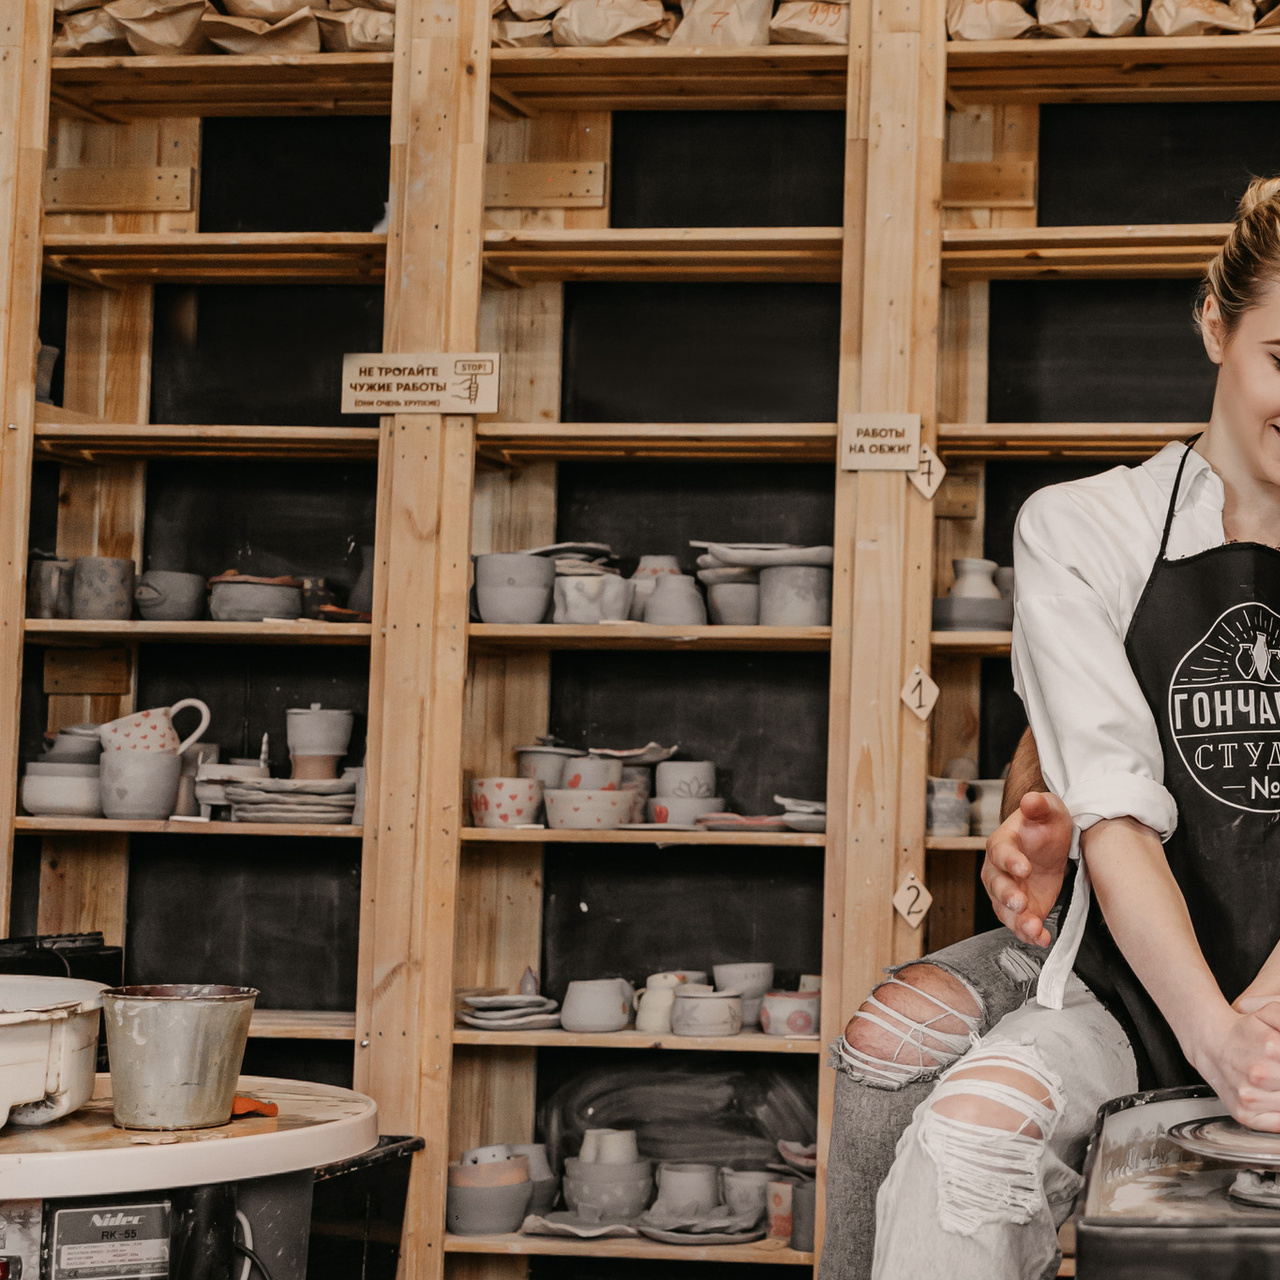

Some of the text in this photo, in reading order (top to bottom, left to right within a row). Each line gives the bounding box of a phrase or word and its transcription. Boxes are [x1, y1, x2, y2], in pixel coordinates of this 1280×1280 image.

[710, 11, 730, 35] 7
[359, 364, 439, 377] НЕ ТРОГАЙТЕ
[350, 382, 447, 392] ЧУЖИЕ РАБОТЫ
[856, 427, 906, 438] РАБОТЫ
[849, 443, 912, 454] НА ОБЖИГ
[919, 459, 934, 487] 7
[911, 678, 927, 709] 1
[906, 884, 924, 916] 2
[89, 1213, 146, 1227] Nidec
